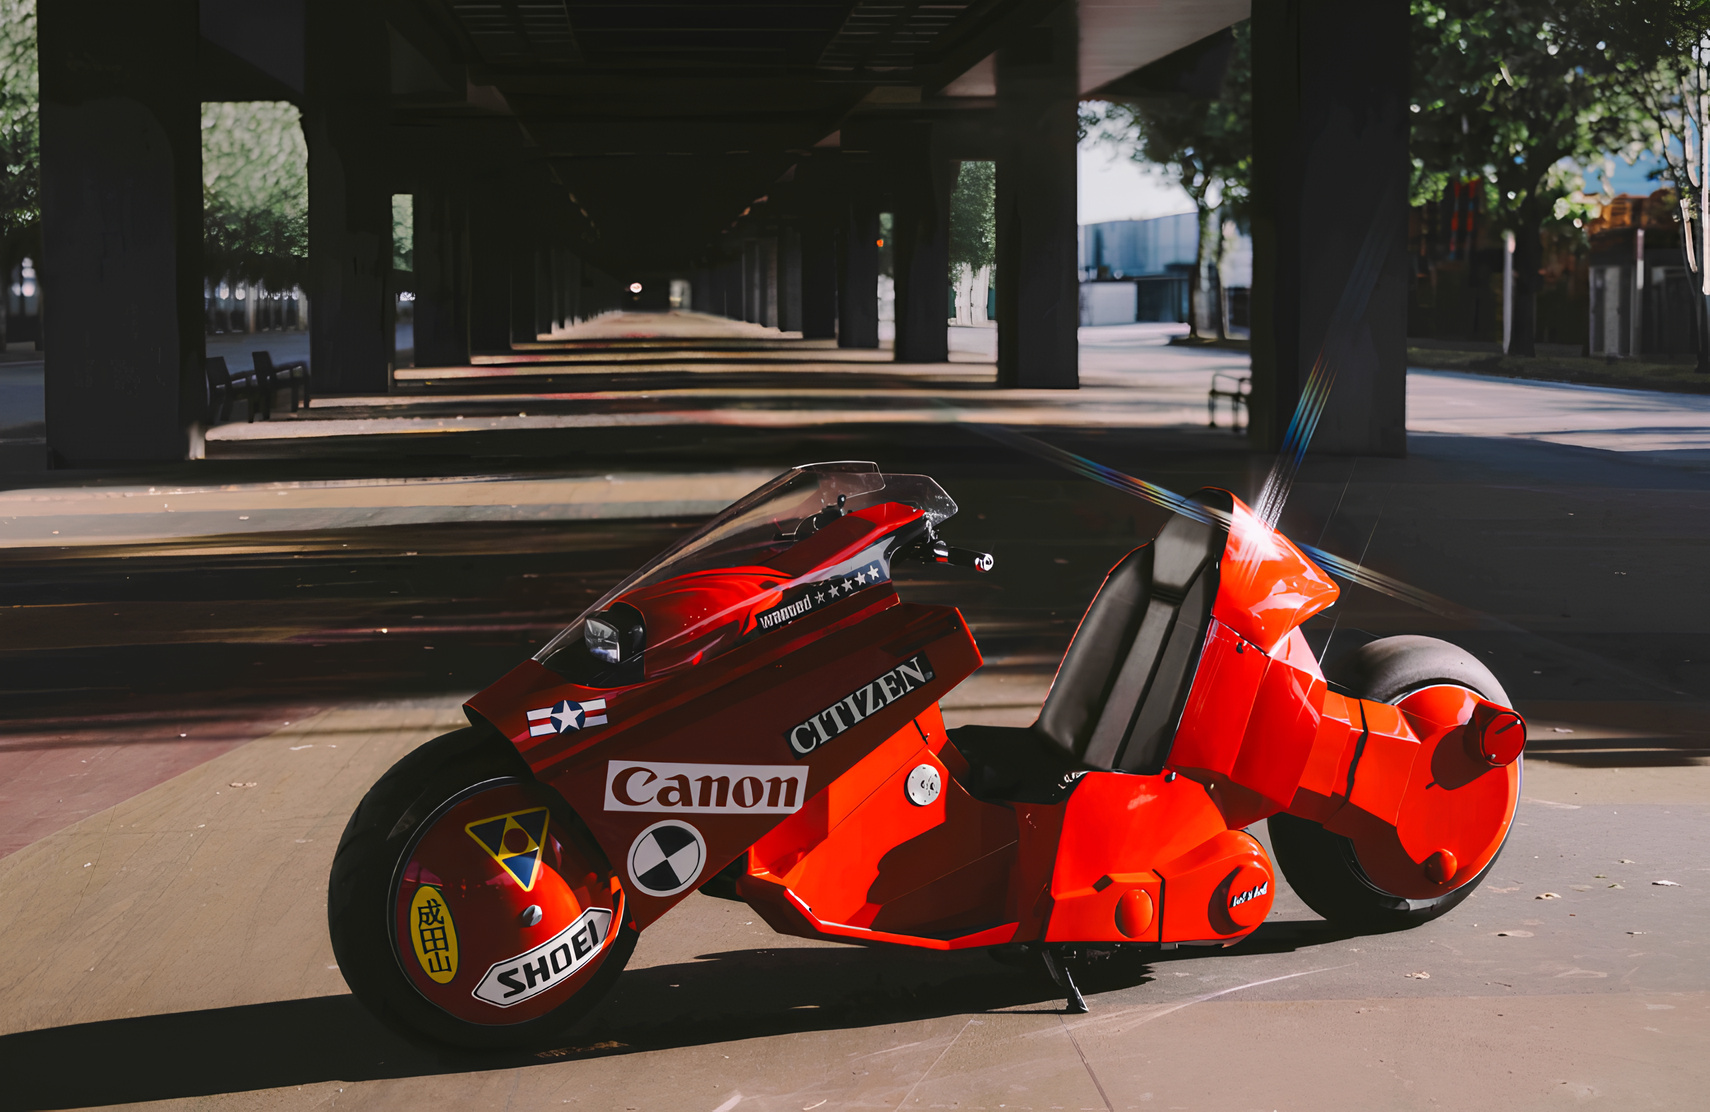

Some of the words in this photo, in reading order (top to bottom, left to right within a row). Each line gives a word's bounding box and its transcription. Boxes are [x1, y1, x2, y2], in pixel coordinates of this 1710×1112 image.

[790, 656, 926, 754] CITIZEN
[611, 766, 799, 808] Canon
[418, 898, 452, 973] 成田山
[497, 919, 598, 998] SHOEI
